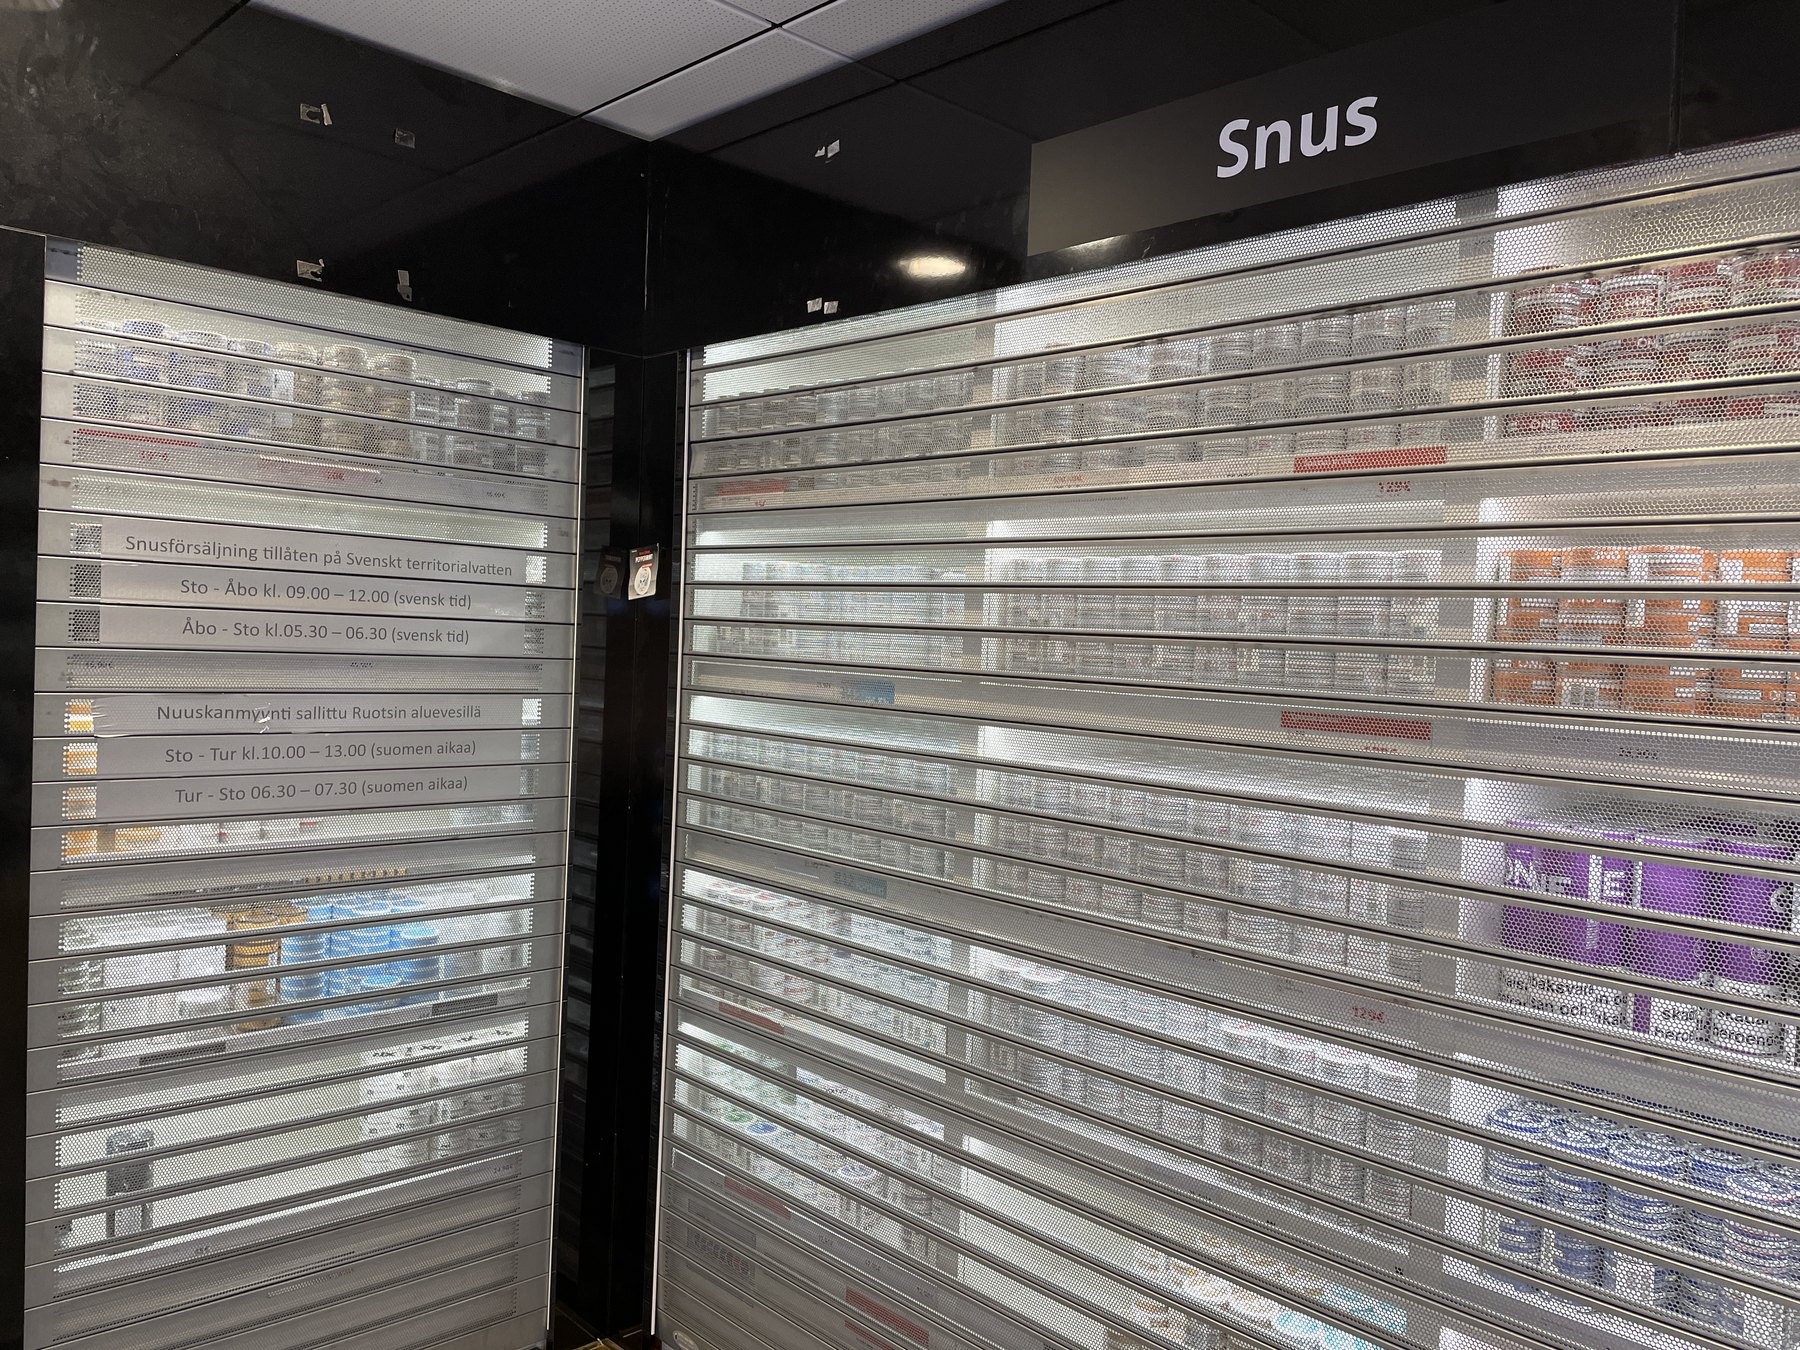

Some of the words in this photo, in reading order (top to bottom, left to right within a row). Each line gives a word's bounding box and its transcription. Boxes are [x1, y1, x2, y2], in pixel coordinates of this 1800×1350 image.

[1217, 96, 1378, 179] Snus
[125, 536, 258, 562] Snusförsäljning
[263, 546, 319, 563] tillåten
[323, 550, 341, 567] på
[346, 552, 402, 569] Svenskt
[406, 557, 512, 576] territorialvatten
[180, 580, 208, 594] Sto
[225, 578, 258, 597] Åbo
[349, 589, 390, 603] 12.00
[394, 590, 445, 607] (svensk
[449, 594, 471, 610] tid)
[182, 616, 217, 635] Åbo
[233, 622, 260, 637] Sto
[346, 626, 387, 640] 06.30
[392, 627, 443, 643] (svensk
[446, 629, 469, 645] tid)
[157, 705, 291, 723] Nuuskanmyynti
[296, 706, 347, 720] sallittu
[352, 706, 407, 719] Ruotsin
[411, 705, 481, 719] aluevesillä
[165, 749, 193, 763] Sto
[210, 747, 237, 761] Tur
[324, 744, 366, 758] 13.00
[371, 742, 432, 759] (suomen
[437, 740, 476, 756] aikaa)
[175, 789, 203, 803] Tur
[219, 787, 246, 801] Sto
[251, 784, 296, 800] 06.30
[314, 781, 357, 796] 07.30
[362, 780, 423, 797] (suomen
[428, 776, 468, 791] aikaa)
